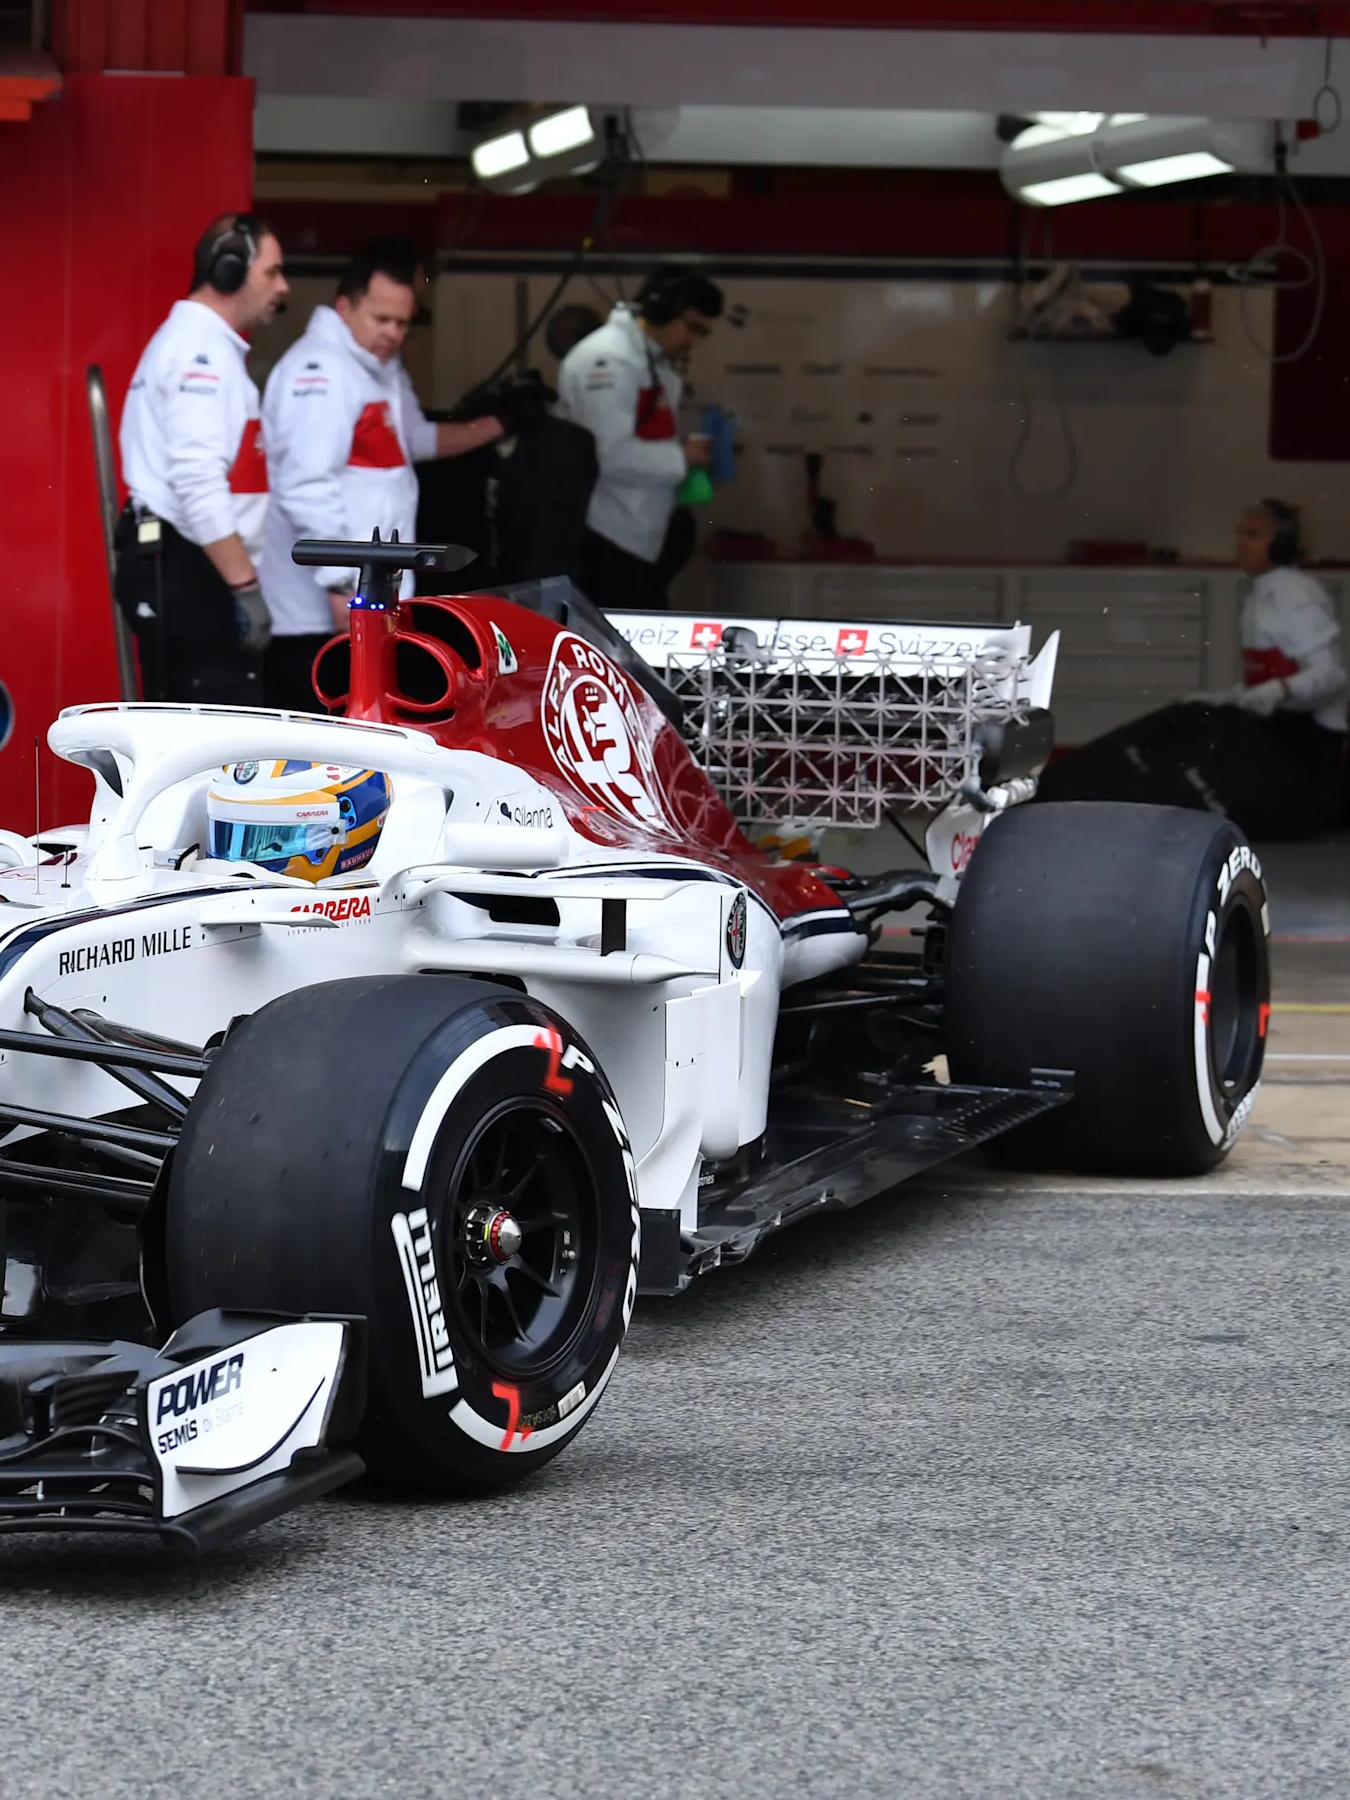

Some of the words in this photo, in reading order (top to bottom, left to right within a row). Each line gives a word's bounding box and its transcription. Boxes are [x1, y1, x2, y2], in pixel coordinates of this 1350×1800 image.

[548, 660, 576, 773] ALFA
[296, 810, 329, 818] CARRERA
[1216, 845, 1262, 907] ZERO
[59, 938, 136, 976] RICHARD
[141, 925, 192, 958] MILLE
[561, 1043, 596, 1075] P
[390, 1206, 460, 1399] PIRELLI
[156, 1353, 245, 1426] POWER
